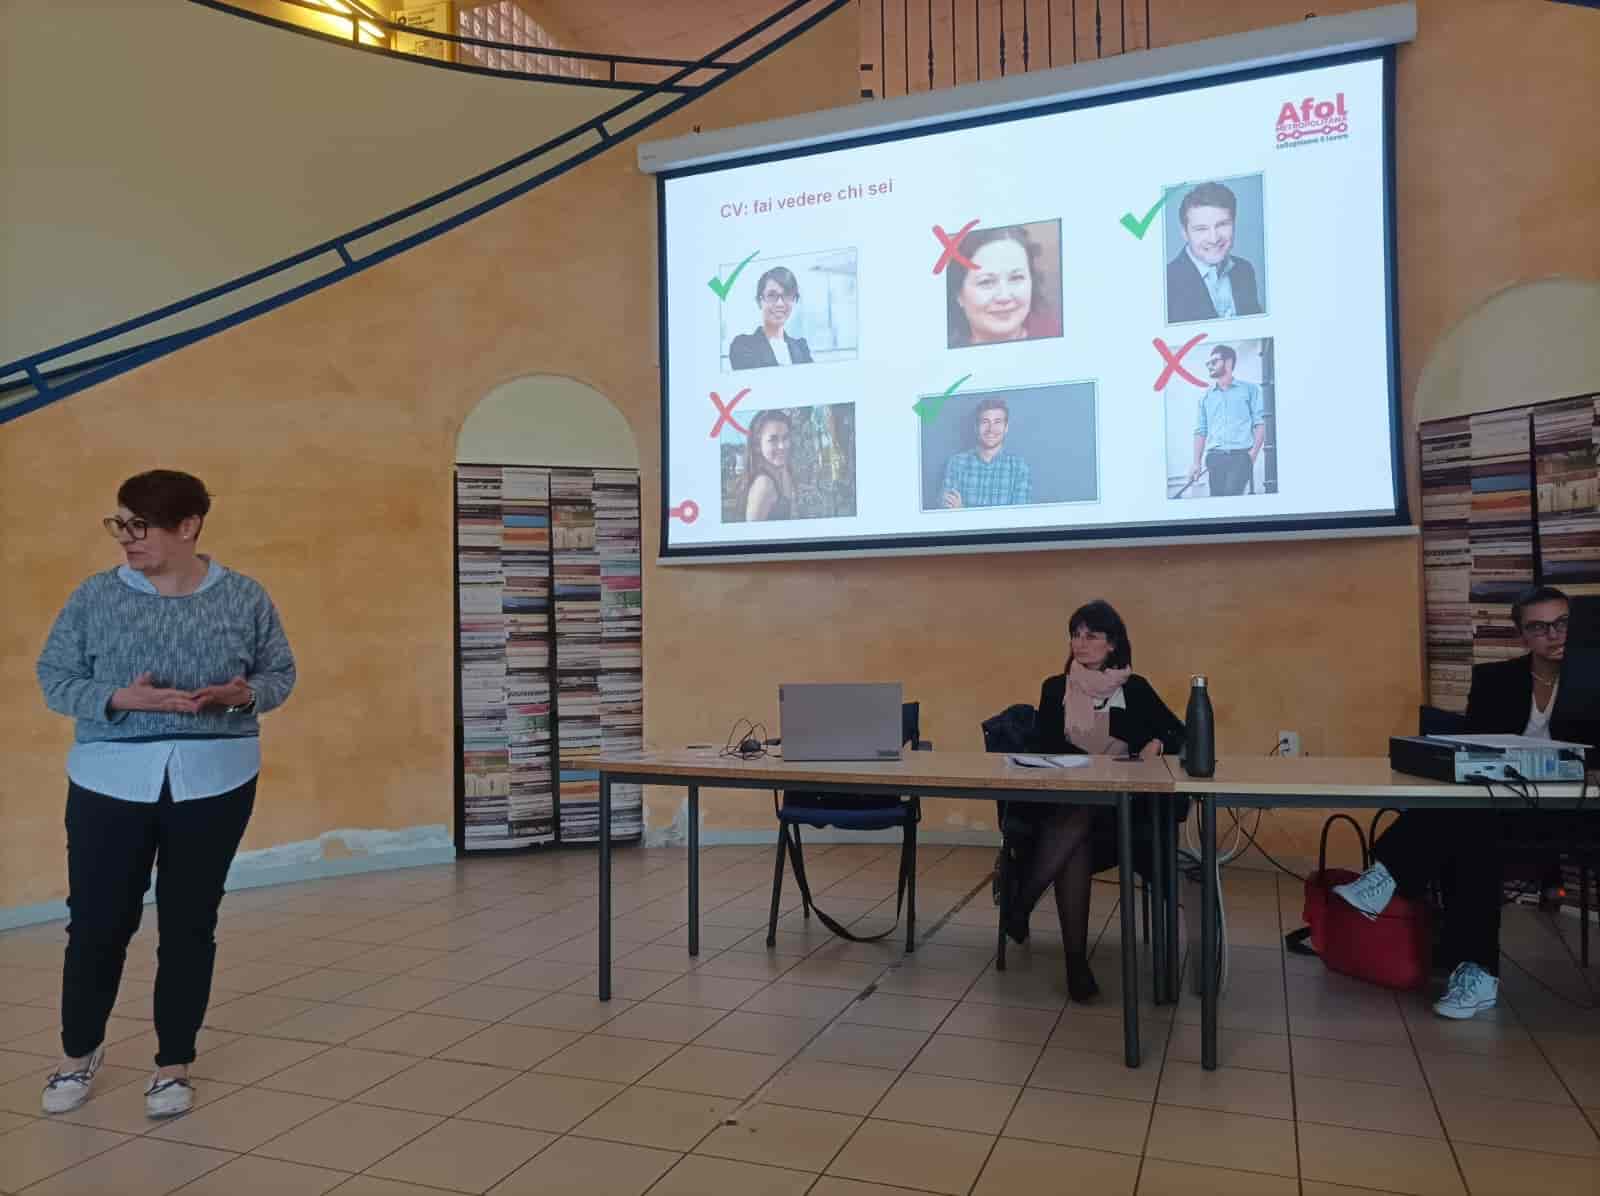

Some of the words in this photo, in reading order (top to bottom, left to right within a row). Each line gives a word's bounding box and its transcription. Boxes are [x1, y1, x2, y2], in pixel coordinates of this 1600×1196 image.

[1276, 92, 1345, 126] Afol
[720, 202, 748, 218] CV:
[753, 197, 772, 214] fai
[777, 190, 833, 209] vedere
[837, 183, 863, 200] chi
[868, 178, 893, 195] sei
